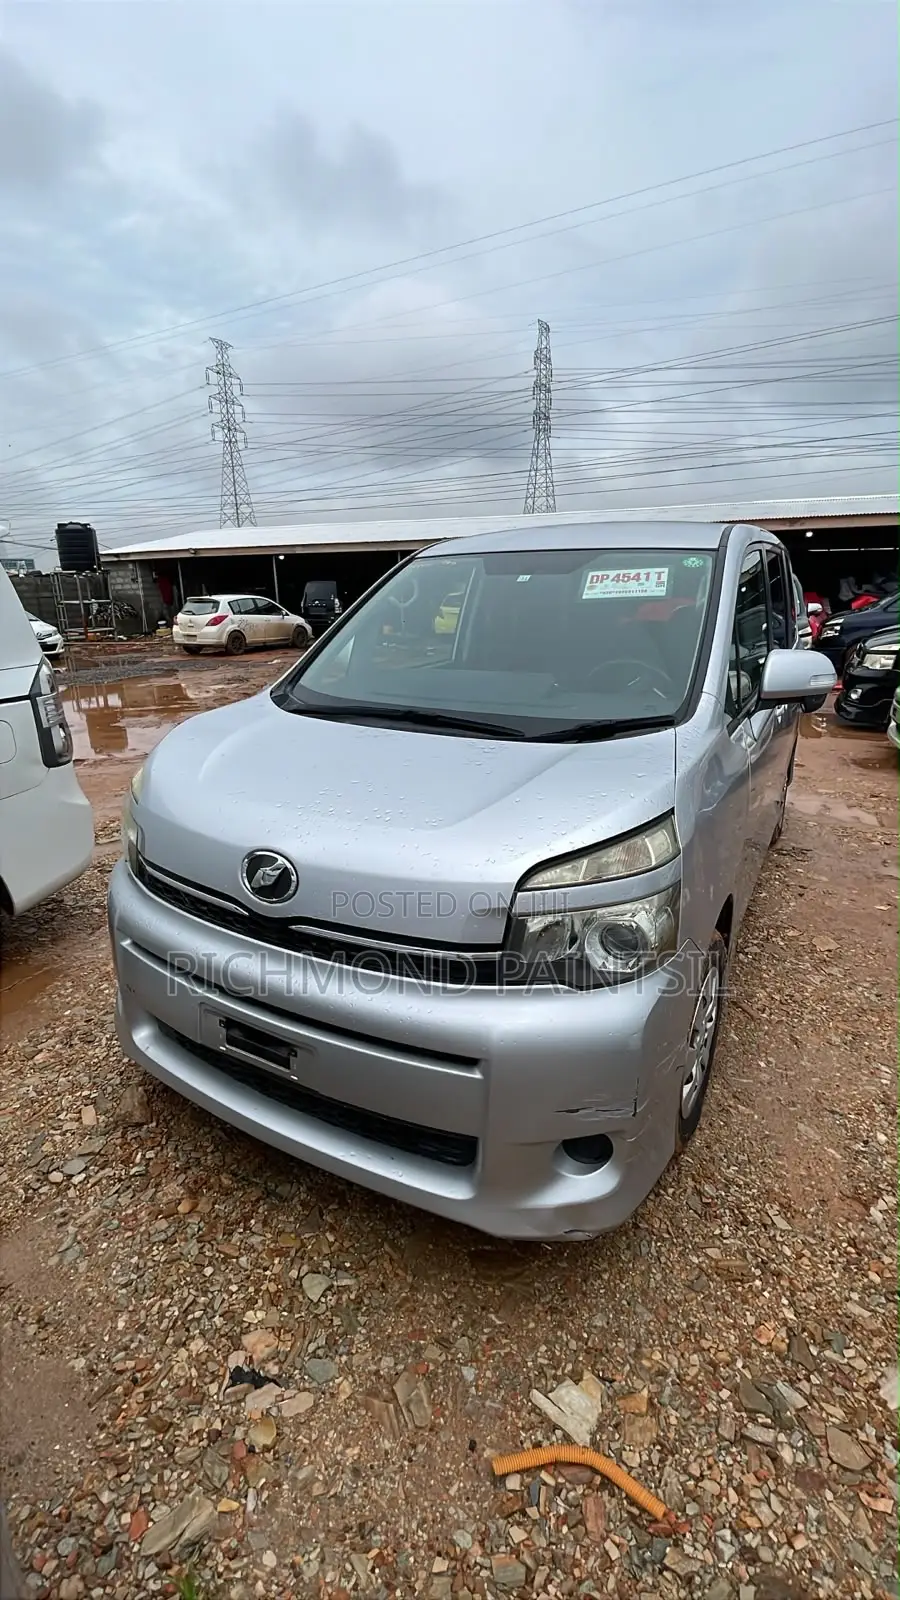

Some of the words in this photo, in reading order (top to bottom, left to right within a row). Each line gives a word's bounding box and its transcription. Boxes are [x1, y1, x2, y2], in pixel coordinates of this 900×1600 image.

[589, 574, 609, 584] DP
[611, 571, 650, 583] 4541
[655, 571, 665, 580] T
